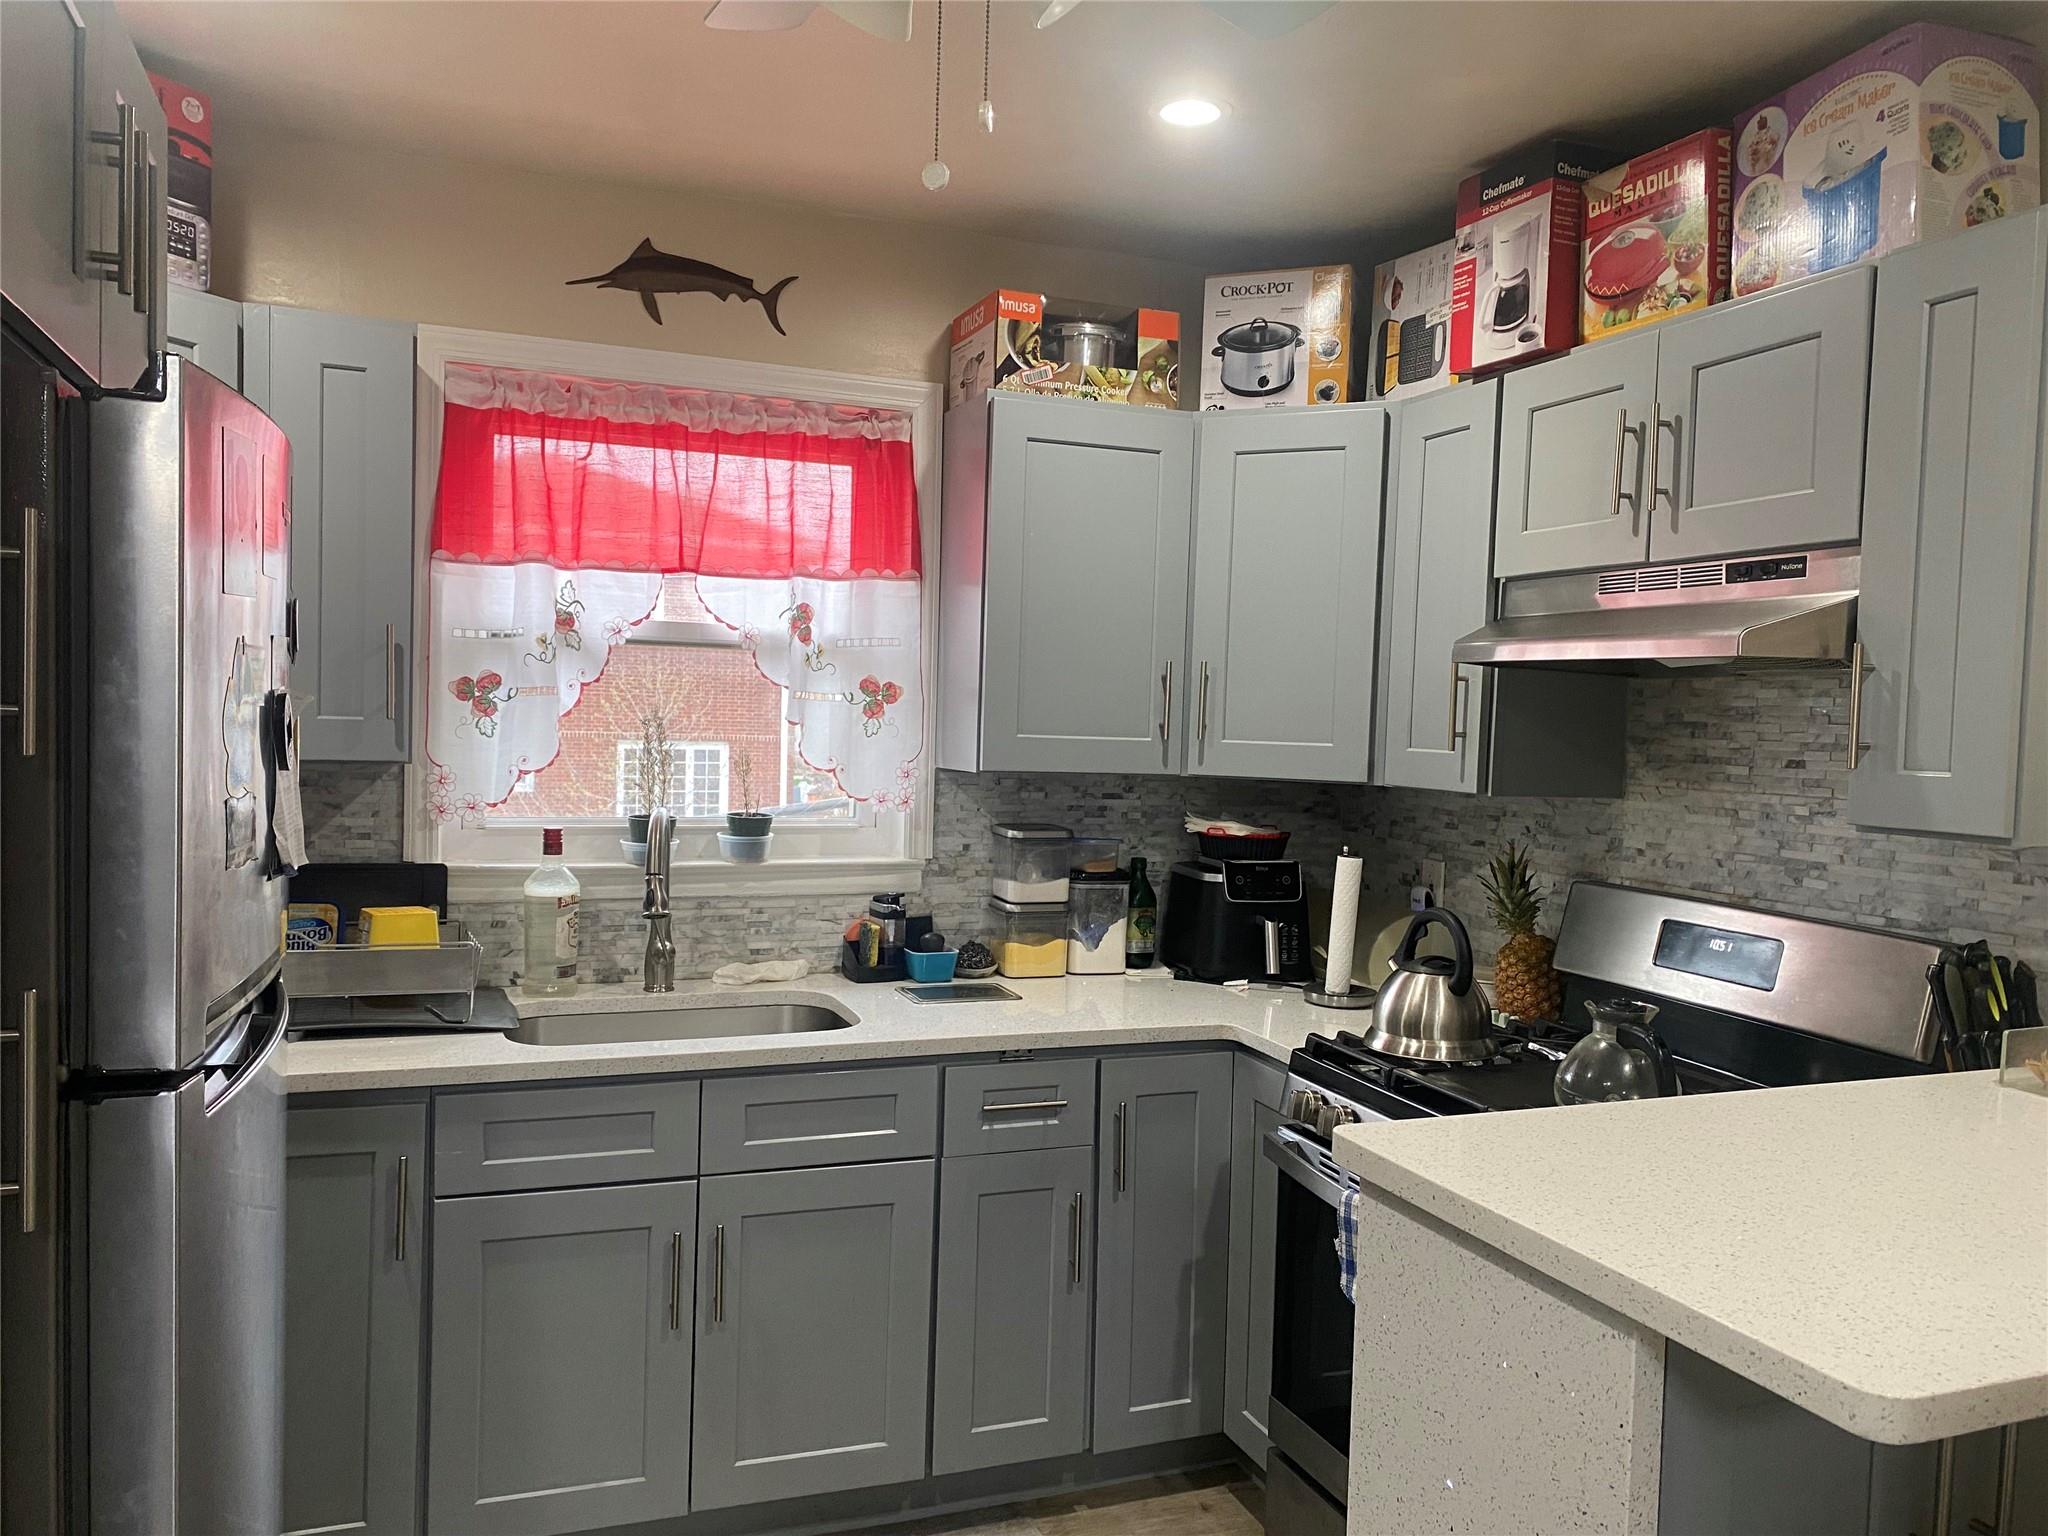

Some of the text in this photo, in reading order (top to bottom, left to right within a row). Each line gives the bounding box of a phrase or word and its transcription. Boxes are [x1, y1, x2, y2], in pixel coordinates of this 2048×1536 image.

[1803, 118, 1817, 137] Ice
[1818, 103, 1855, 129] Cream
[1857, 82, 1897, 109] Maker
[1876, 109, 1887, 122] 4
[1482, 176, 1526, 201] Chefmate
[1588, 160, 1703, 219] QUESADILL
[1481, 190, 1533, 217] 12-Cup Coffeemaker
[1715, 135, 1732, 280] QUESADILLA
[1001, 298, 1036, 314] imusa
[960, 305, 985, 338] imusa
[1002, 374, 1008, 383] 6
[1064, 381, 1099, 394] Pressure
